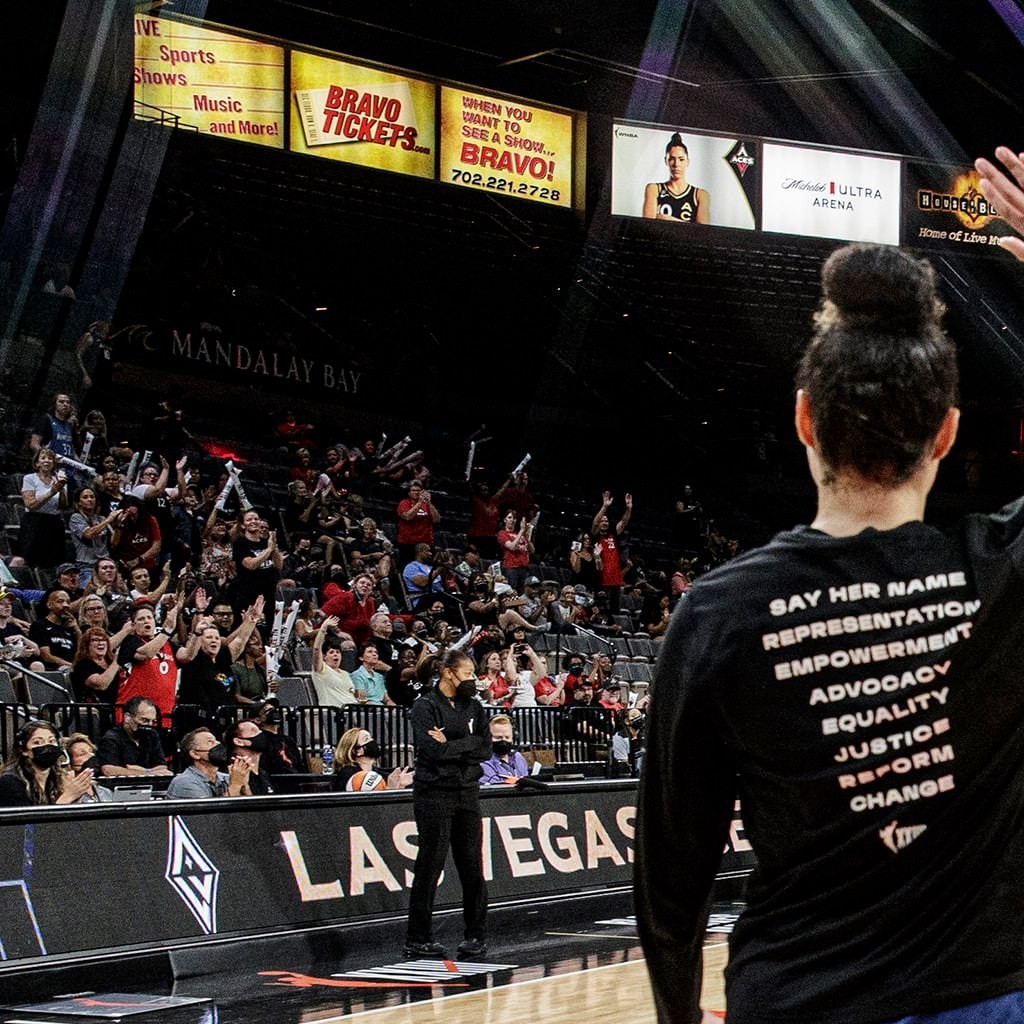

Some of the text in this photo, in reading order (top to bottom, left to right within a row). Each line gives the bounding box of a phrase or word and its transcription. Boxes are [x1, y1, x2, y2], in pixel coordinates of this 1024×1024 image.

[134, 19, 161, 37] IVE
[160, 45, 216, 66] Sports
[134, 67, 188, 86] Shows
[193, 95, 243, 113] Music
[325, 85, 402, 122] BRAVO
[462, 96, 533, 123] WHEN YOU
[209, 120, 279, 136] and More!
[462, 110, 521, 134] WANT TO
[462, 125, 489, 142] SEE
[491, 132, 501, 144] A
[460, 141, 556, 182] BRAVO!
[451, 169, 560, 201] 702.221.2728
[839, 184, 883, 200] ULTRA
[812, 197, 854, 211] ARENA
[919, 228, 947, 239] Home
[948, 231, 963, 241] of
[964, 232, 988, 244] Live
[172, 329, 361, 394] MANDALAY BAY
[769, 571, 966, 616] SAY HER NAME
[762, 599, 981, 650] REPRESENTATION
[774, 621, 973, 681] EMPOWERMENT
[809, 660, 951, 706] ADVOCACY
[821, 686, 949, 736] EQUALITY
[834, 717, 950, 763] JUSTICE
[850, 774, 955, 812] CHANGE
